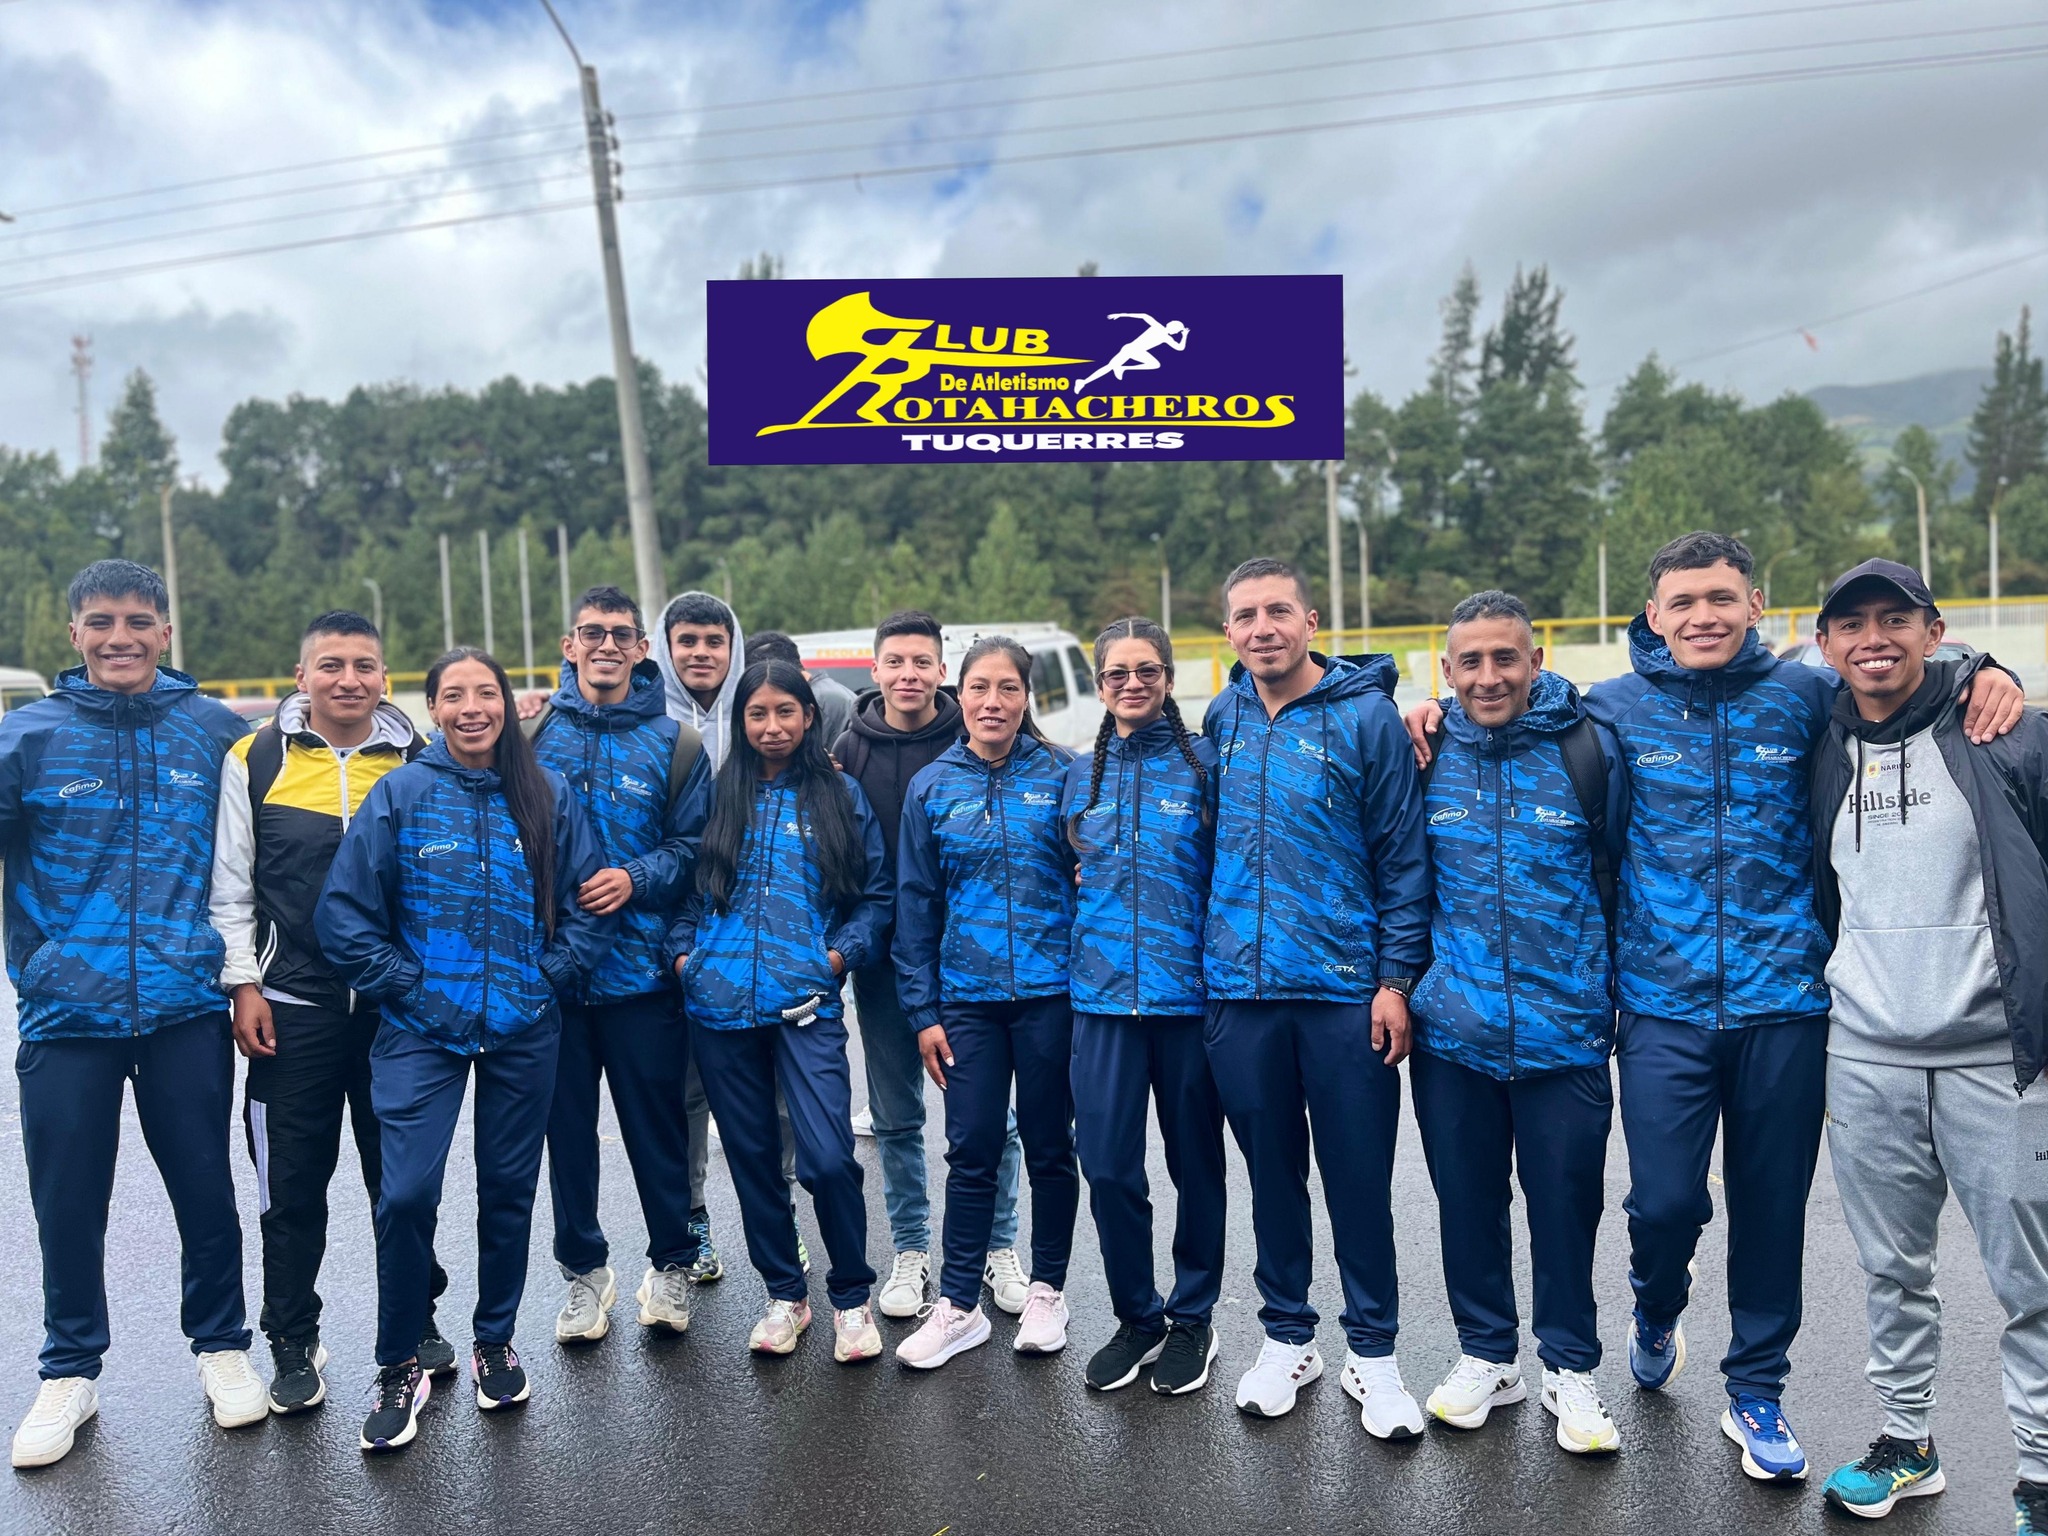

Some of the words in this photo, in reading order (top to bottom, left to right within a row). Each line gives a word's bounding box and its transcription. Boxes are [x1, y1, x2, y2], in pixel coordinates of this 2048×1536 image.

[1641, 755, 1674, 764] cafima
[1881, 762, 1911, 771] NARIO
[64, 781, 97, 794] cafima
[1848, 788, 1931, 814] Hillside
[1433, 810, 1462, 821] cafima
[1868, 812, 1889, 820] SINCE
